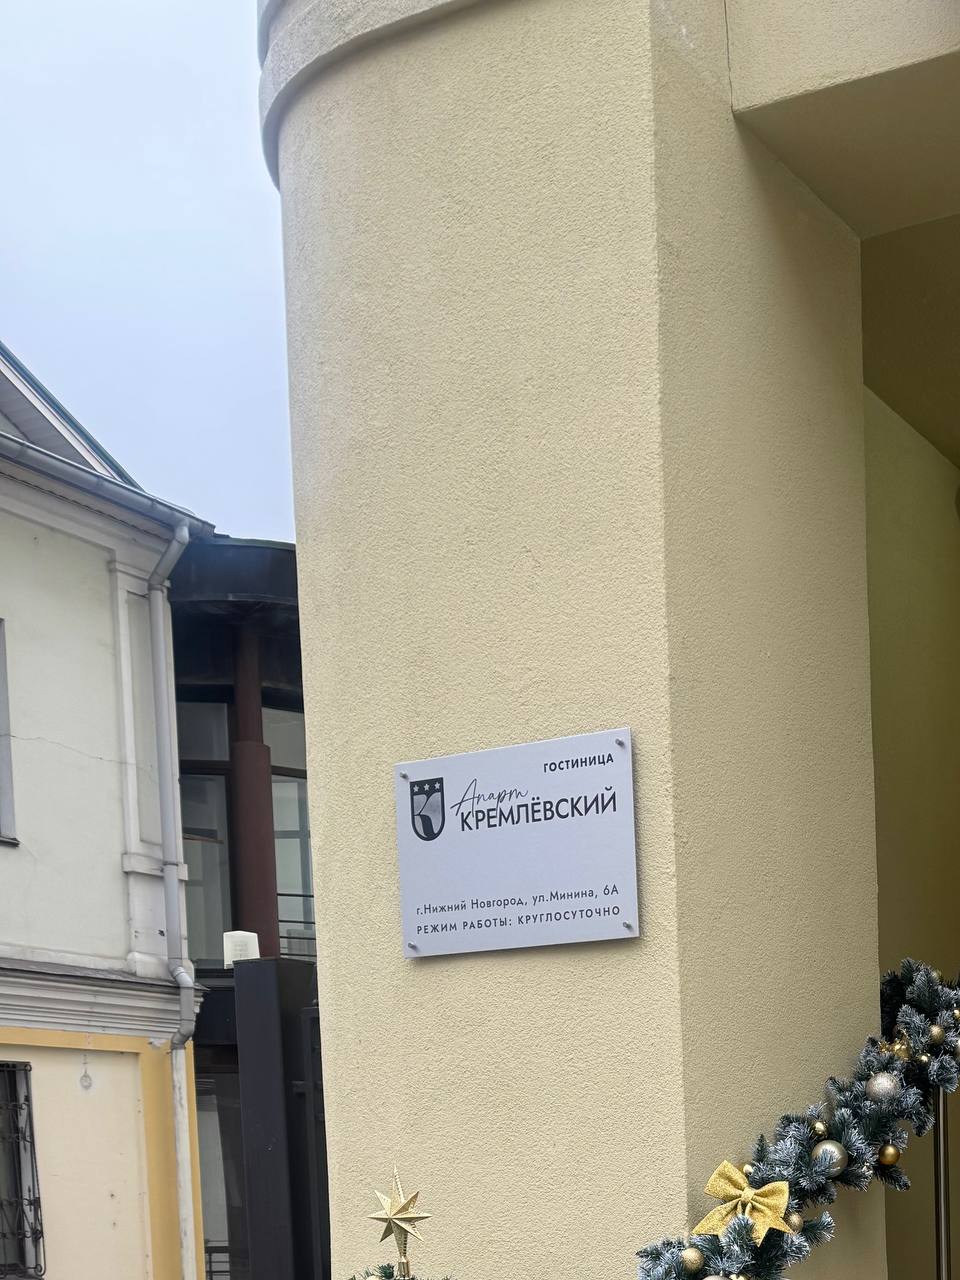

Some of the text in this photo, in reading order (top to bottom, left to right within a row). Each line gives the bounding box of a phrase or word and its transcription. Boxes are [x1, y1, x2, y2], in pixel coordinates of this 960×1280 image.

[543, 752, 614, 773] ГОСТИНИЦА
[450, 778, 528, 817] Апарт
[460, 785, 617, 832] КРЕМЛЁВСКИЙ
[416, 884, 619, 915] г.Нижний Новгород, ул.Минина, 6А
[416, 905, 621, 935] РЕЖИМ РАБОТЫ: КРУГЛОСУТОЧНО
